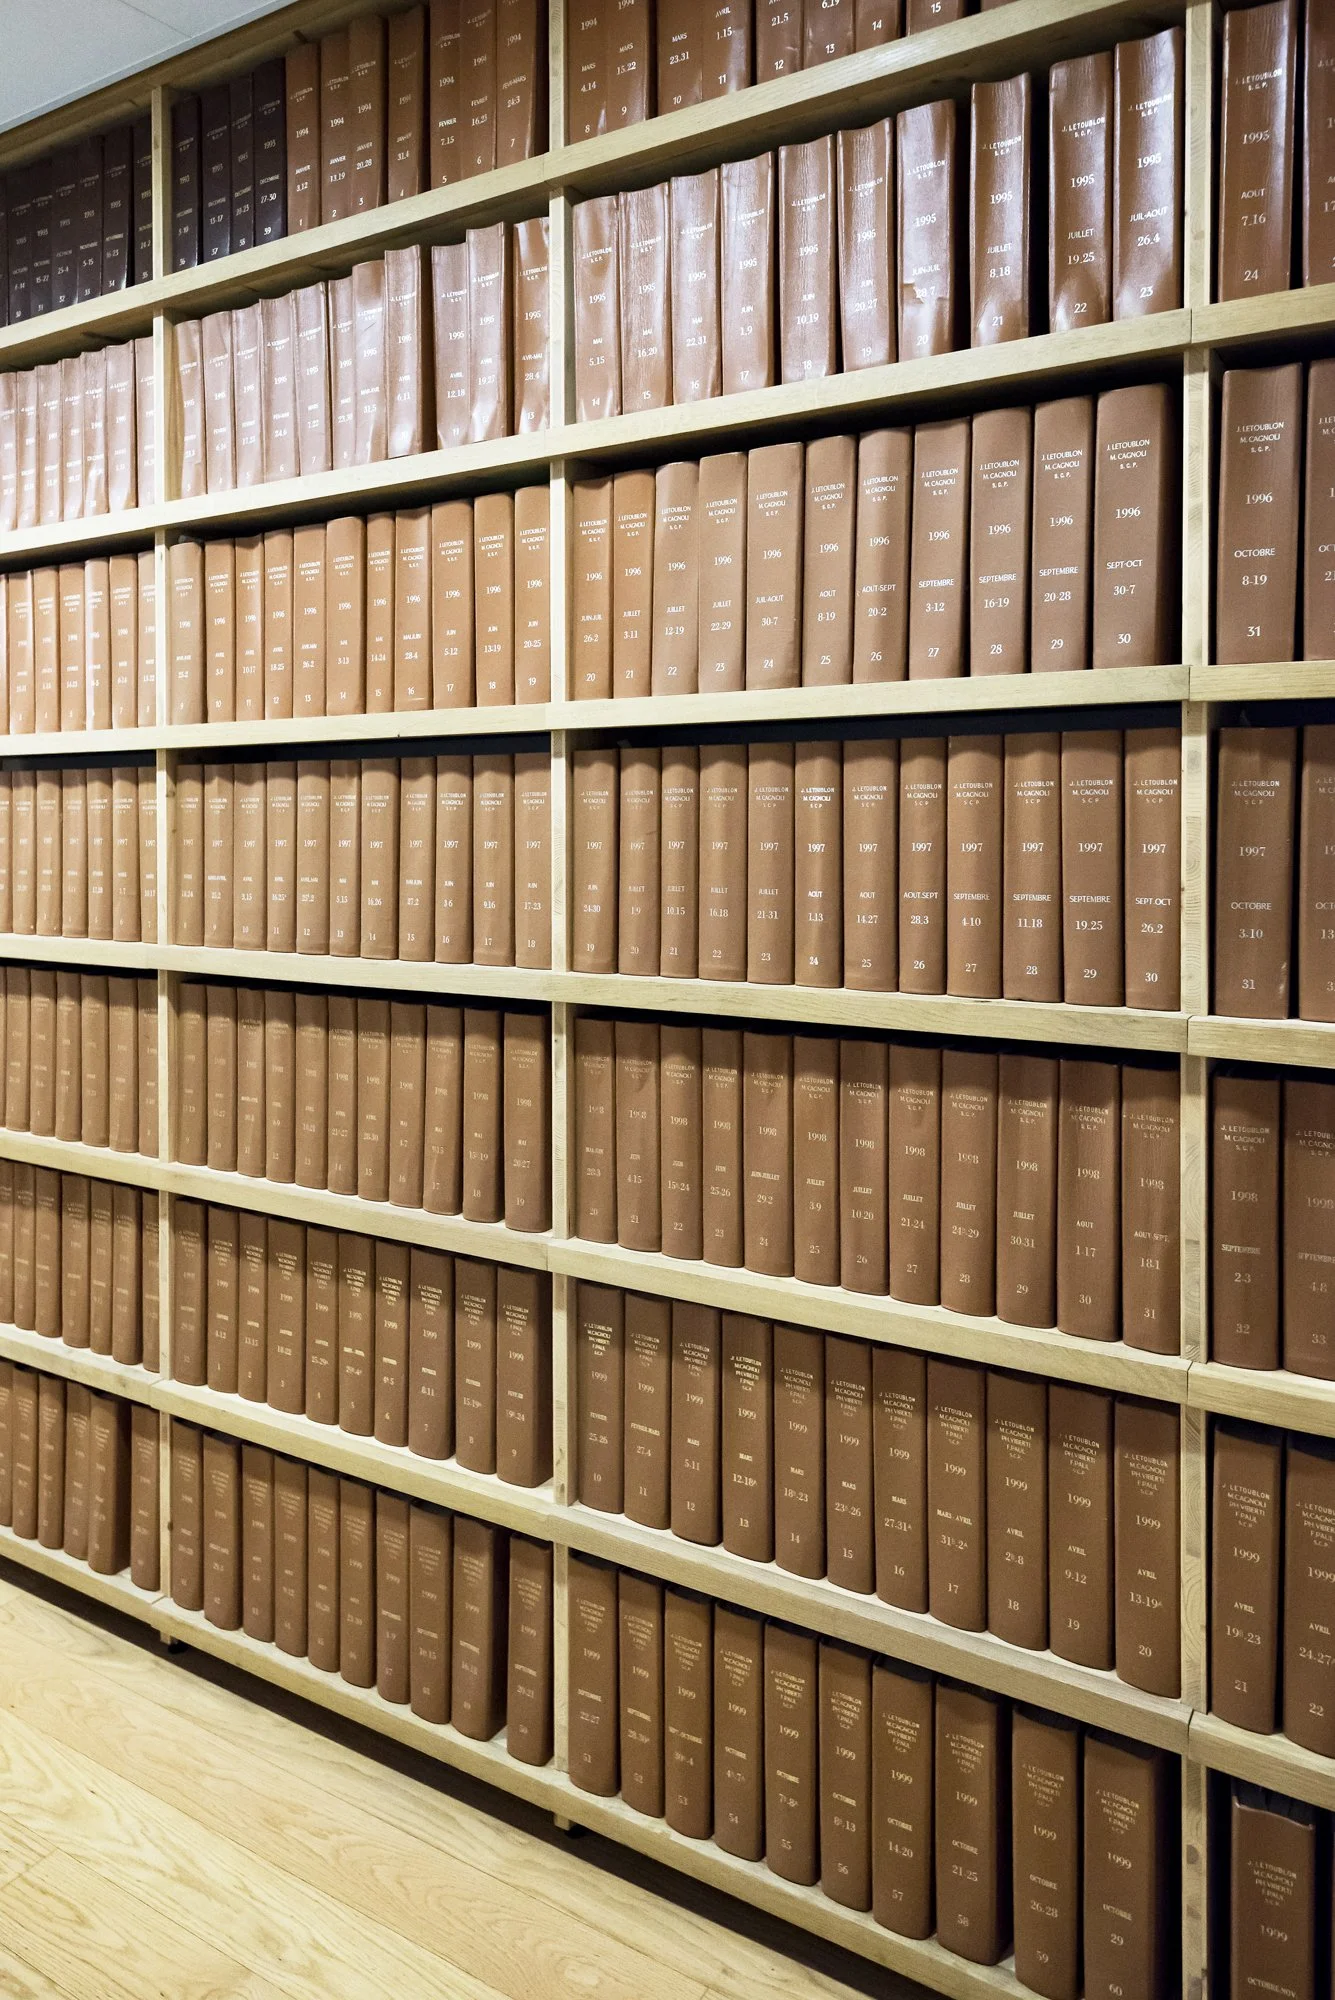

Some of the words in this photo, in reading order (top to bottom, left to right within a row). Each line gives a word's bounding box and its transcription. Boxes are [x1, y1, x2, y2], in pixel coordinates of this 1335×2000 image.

[930, 2, 942, 14] 15
[872, 19, 882, 30] 14
[671, 32, 688, 42] MARS
[825, 43, 835, 54] 13
[774, 59, 784, 70] 12
[439, 75, 455, 87] 1994
[718, 73, 727, 84] 11
[672, 94, 682, 105] 10
[330, 116, 345, 128] 1994
[1069, 116, 1106, 133] LETOUBLON
[1242, 129, 1270, 145] 1995
[1136, 152, 1162, 169] 1995
[441, 175, 447, 183] 5
[1070, 173, 1096, 188] 1995
[990, 190, 1013, 205] 1995
[1240, 188, 1265, 200] AOUT
[1067, 228, 1095, 239] JUILLET
[799, 244, 819, 256] 1995
[1244, 269, 1259, 281] 24
[1139, 285, 1154, 298] 23
[1073, 302, 1087, 314] 22
[991, 315, 1004, 326] 21
[802, 359, 812, 370] 18
[739, 370, 749, 382] 17
[1244, 421, 1284, 432] LETOUBLON
[1112, 438, 1151, 451] LETOUBLON
[1245, 491, 1273, 505] 1996
[1115, 506, 1141, 519] 1996
[1049, 514, 1074, 527] 1996
[988, 523, 1012, 535] 1996
[869, 535, 890, 547] 1996
[928, 529, 951, 542] 1996
[819, 542, 839, 554] 1996
[1233, 547, 1275, 558] OCTOBRE
[763, 548, 782, 560] 1996
[714, 554, 732, 566] 1996
[668, 560, 686, 572] 1996
[1038, 566, 1079, 577] SEPTEMBRE
[526, 578, 543, 589] 1996
[918, 578, 955, 589] SEPTEMBRE
[978, 573, 1017, 584] SEPTEMBRE
[818, 589, 837, 598] AOUT
[1246, 625, 1261, 637] 31
[1050, 638, 1064, 650] 29
[1117, 633, 1132, 645] 30
[927, 647, 940, 658] 27
[989, 643, 1003, 655] 28
[820, 654, 831, 665] 25
[870, 651, 882, 662] 26
[715, 662, 725, 672] 23
[763, 658, 774, 669] 24
[625, 669, 634, 679] 21
[667, 666, 677, 676] 22
[527, 676, 537, 686] 19
[1140, 778, 1178, 786] LETOUBLON
[760, 841, 779, 851] 1997
[807, 843, 826, 853] 1997
[859, 843, 878, 853] 1997
[911, 842, 932, 852] 1997
[961, 842, 983, 853] 1997
[1021, 842, 1044, 853] 1997
[1078, 842, 1103, 853] 1997
[1141, 843, 1167, 854] 1997
[1239, 846, 1266, 857] 1997
[859, 891, 875, 899] AOUT
[953, 892, 990, 901] SEPTEMBRE
[1012, 893, 1052, 902] SEPTEMBRE
[1069, 894, 1111, 904] SEPTEMBRE
[1230, 901, 1272, 911] OCTOBRE
[527, 939, 536, 948] 18
[761, 952, 771, 961] 23
[809, 955, 819, 966] 24
[861, 958, 872, 968] 25
[913, 959, 926, 970] 26
[965, 962, 977, 973] 27
[1025, 965, 1038, 975] 28
[1083, 967, 1097, 979] 29
[1145, 972, 1158, 983] 30
[1241, 978, 1255, 990] 31
[807, 1131, 827, 1143] 1998
[855, 1138, 875, 1150] 1998
[903, 1145, 926, 1158] 1998
[1015, 1159, 1039, 1172] 1998
[902, 1193, 924, 1203] JUILLET
[673, 1221, 683, 1231] 22
[1076, 1219, 1094, 1229] AOUT
[809, 1244, 820, 1254] 25
[856, 1254, 868, 1264] 26
[906, 1263, 918, 1274] 27
[1016, 1283, 1029, 1295] 29
[1078, 1294, 1092, 1305] 30
[1143, 1307, 1156, 1319] 31
[1235, 1322, 1250, 1335] 32
[422, 1329, 437, 1340] 1999
[737, 1408, 756, 1420] 1999
[839, 1434, 860, 1447] 1999
[511, 1448, 517, 1456] 9
[889, 1447, 910, 1460] 1999
[1005, 1476, 1028, 1491] 1999
[1067, 1493, 1092, 1508] 1999
[739, 1518, 749, 1528] 13
[1135, 1514, 1161, 1530] 1999
[1067, 1545, 1086, 1556] AVRIL
[1233, 1547, 1260, 1563] 1999
[893, 1564, 905, 1576] 16
[1137, 1568, 1157, 1579] AVRIL
[1007, 1598, 1020, 1611] 18
[1233, 1601, 1255, 1614] AVRIL
[1067, 1617, 1080, 1630] 19
[1138, 1644, 1153, 1657] 20
[1234, 1679, 1248, 1692] 21
[1308, 1702, 1324, 1716] 22
[835, 1745, 856, 1761] 1999
[891, 1769, 913, 1784] 1999
[1033, 1824, 1057, 1841] 1999
[1107, 1851, 1132, 1870] 1999
[891, 1888, 904, 1901] 57
[1110, 1933, 1124, 1946] 29
[1108, 1983, 1123, 1997] 60
